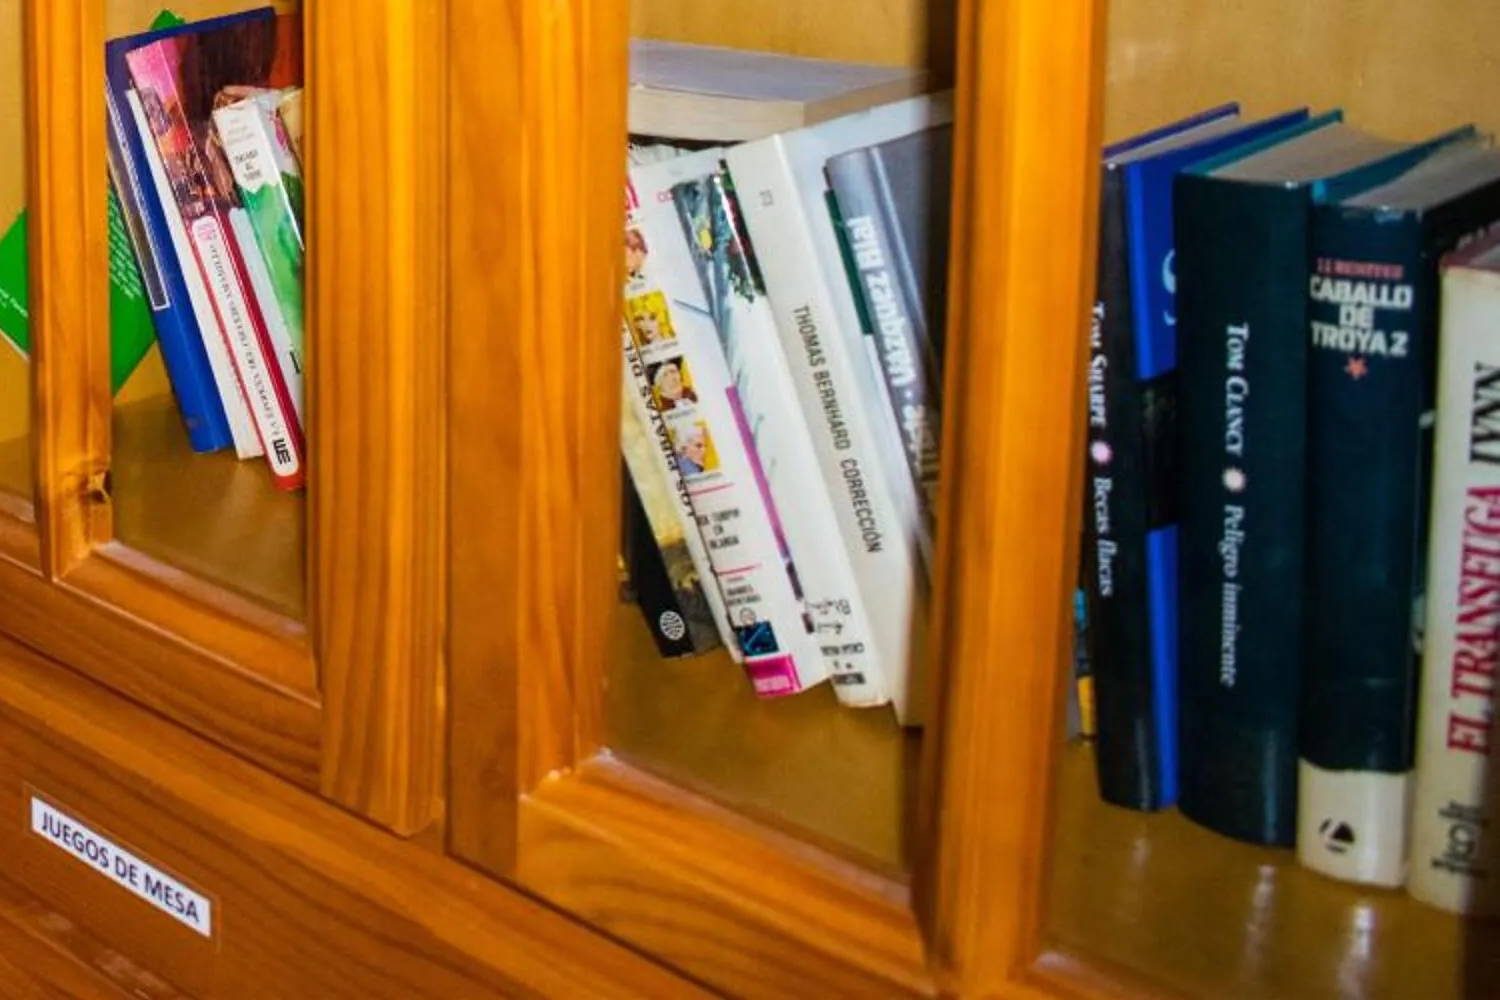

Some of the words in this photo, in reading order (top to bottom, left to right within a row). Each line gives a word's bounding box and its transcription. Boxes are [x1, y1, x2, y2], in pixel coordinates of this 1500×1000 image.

[1310, 274, 1413, 310] CABALLO
[1339, 303, 1374, 329] DE
[1310, 320, 1388, 356] TROYA
[794, 305, 826, 367] THOMAS
[813, 370, 851, 450] BERNHARD
[840, 458, 882, 553] CORRECCIÓN
[1093, 477, 1113, 534] Becas
[1217, 503, 1246, 579] Peligro
[1219, 582, 1243, 689] inminente
[41, 811, 109, 869] JUEGOS
[115, 855, 139, 887] DE
[145, 872, 200, 923] MESA
